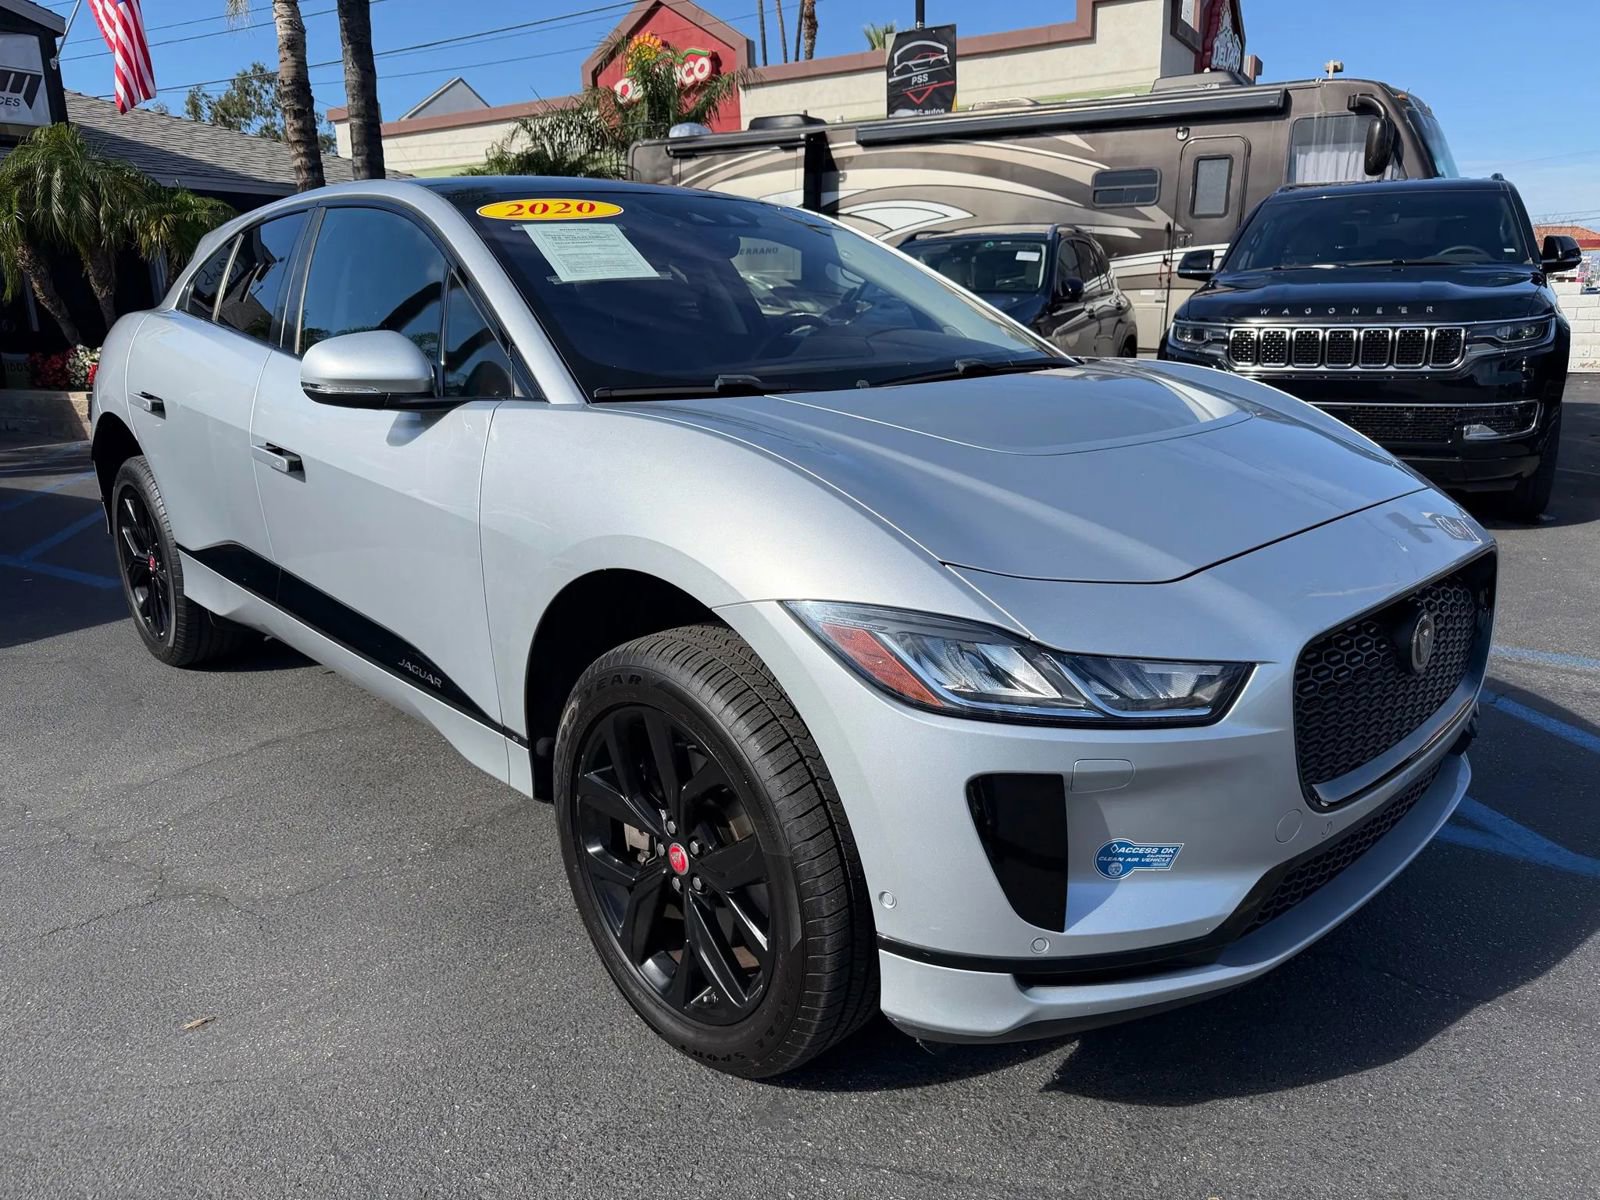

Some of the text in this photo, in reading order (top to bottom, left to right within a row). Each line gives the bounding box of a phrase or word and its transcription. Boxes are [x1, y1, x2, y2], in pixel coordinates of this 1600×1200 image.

[911, 73, 929, 85] PSS
[505, 202, 596, 216] 2020
[1260, 306, 1433, 315] WAGONEER
[397, 659, 442, 688] JAGUAR
